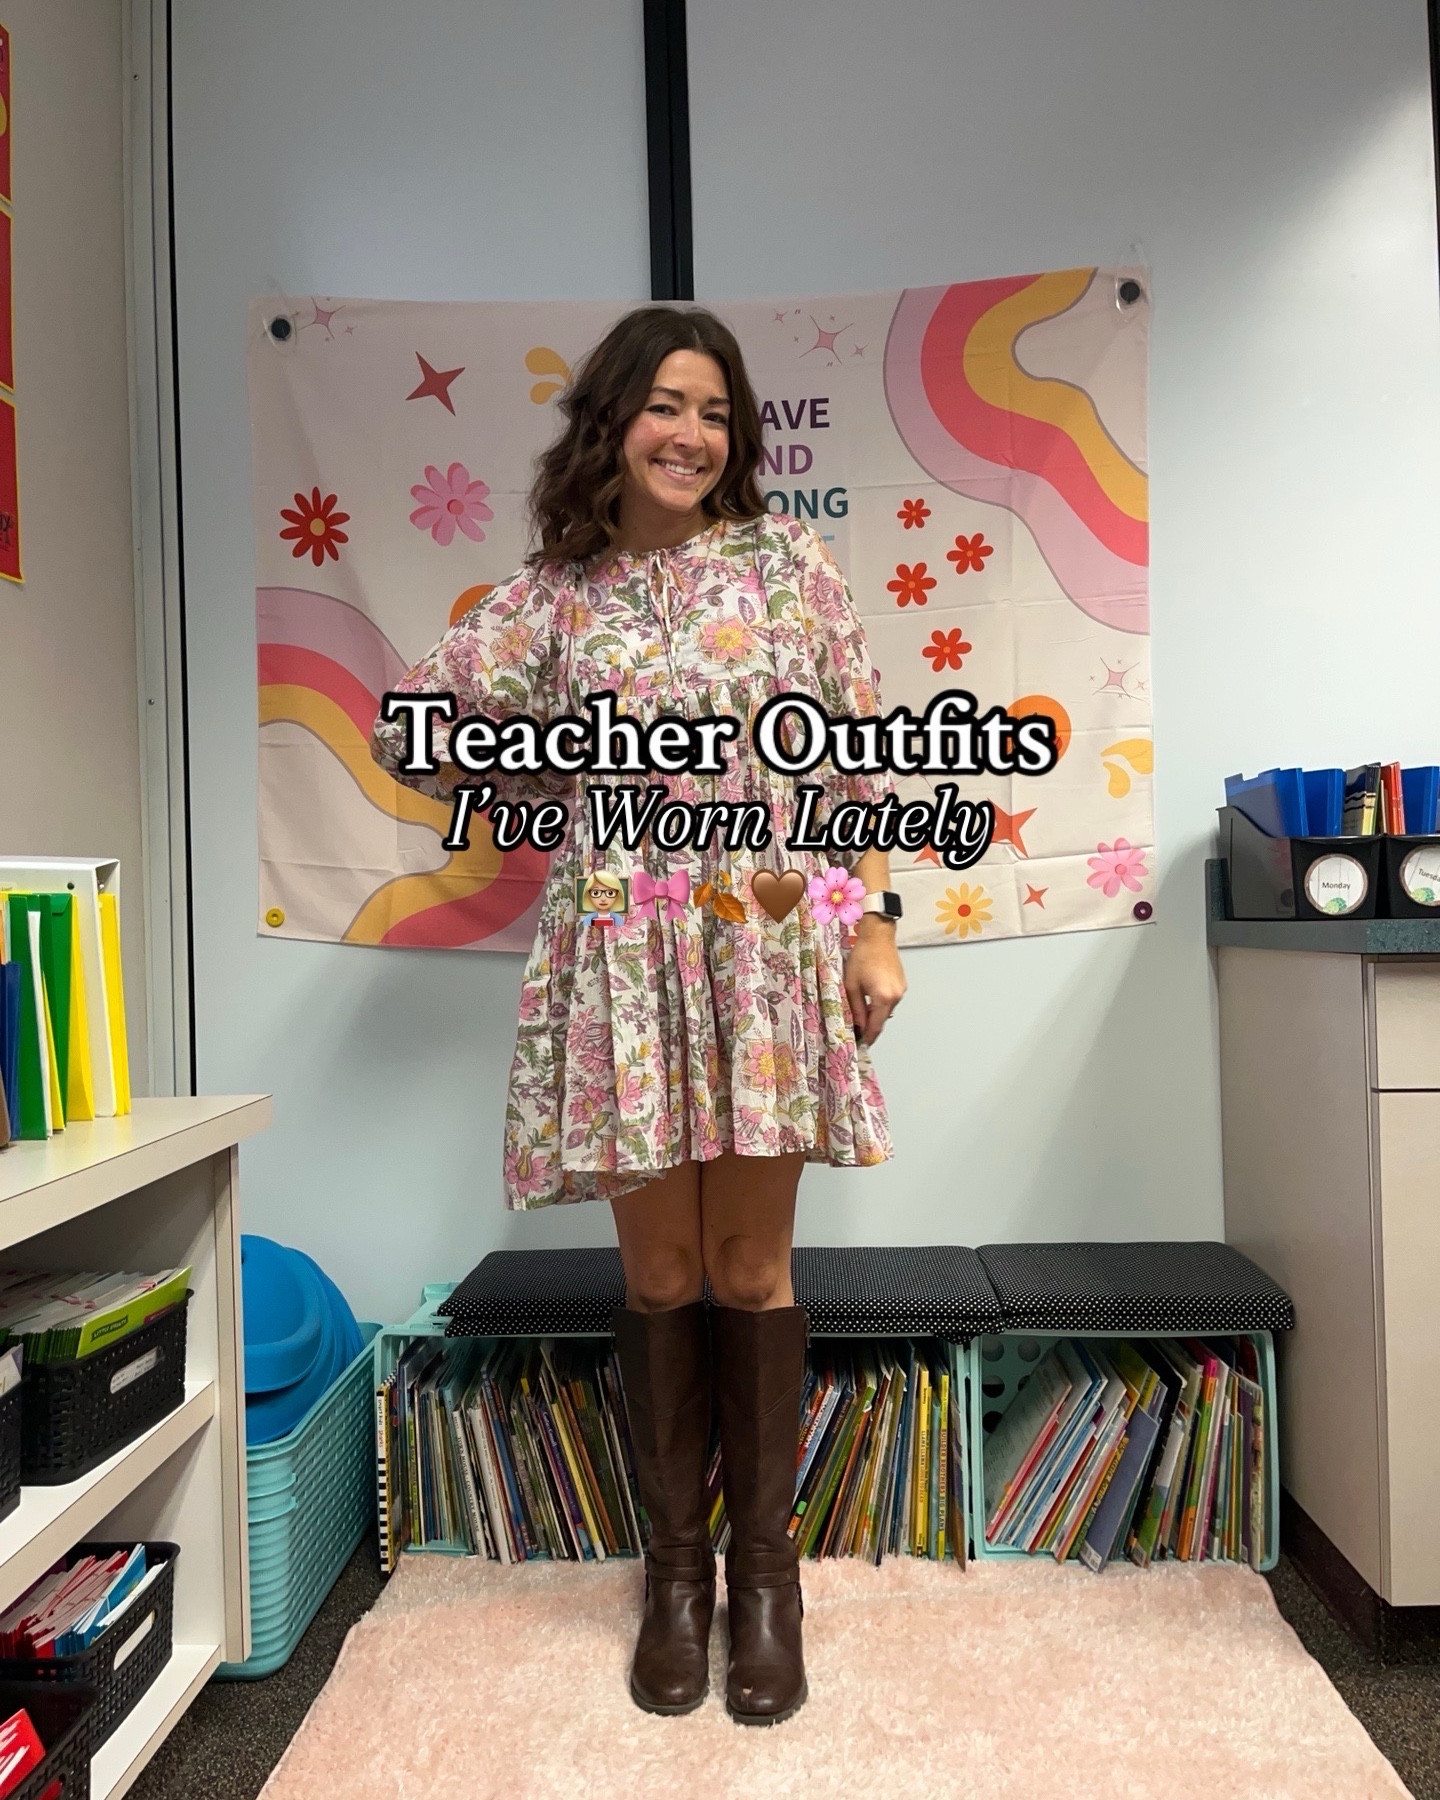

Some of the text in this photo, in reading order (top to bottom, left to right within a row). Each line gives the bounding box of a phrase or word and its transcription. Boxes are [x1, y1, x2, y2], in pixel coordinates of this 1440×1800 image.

[759, 397, 830, 431] AVE
[758, 444, 813, 476] ND
[763, 487, 848, 519] ONG
[1322, 881, 1351, 890] Monday
[1418, 868, 1440, 882] Tuesda
